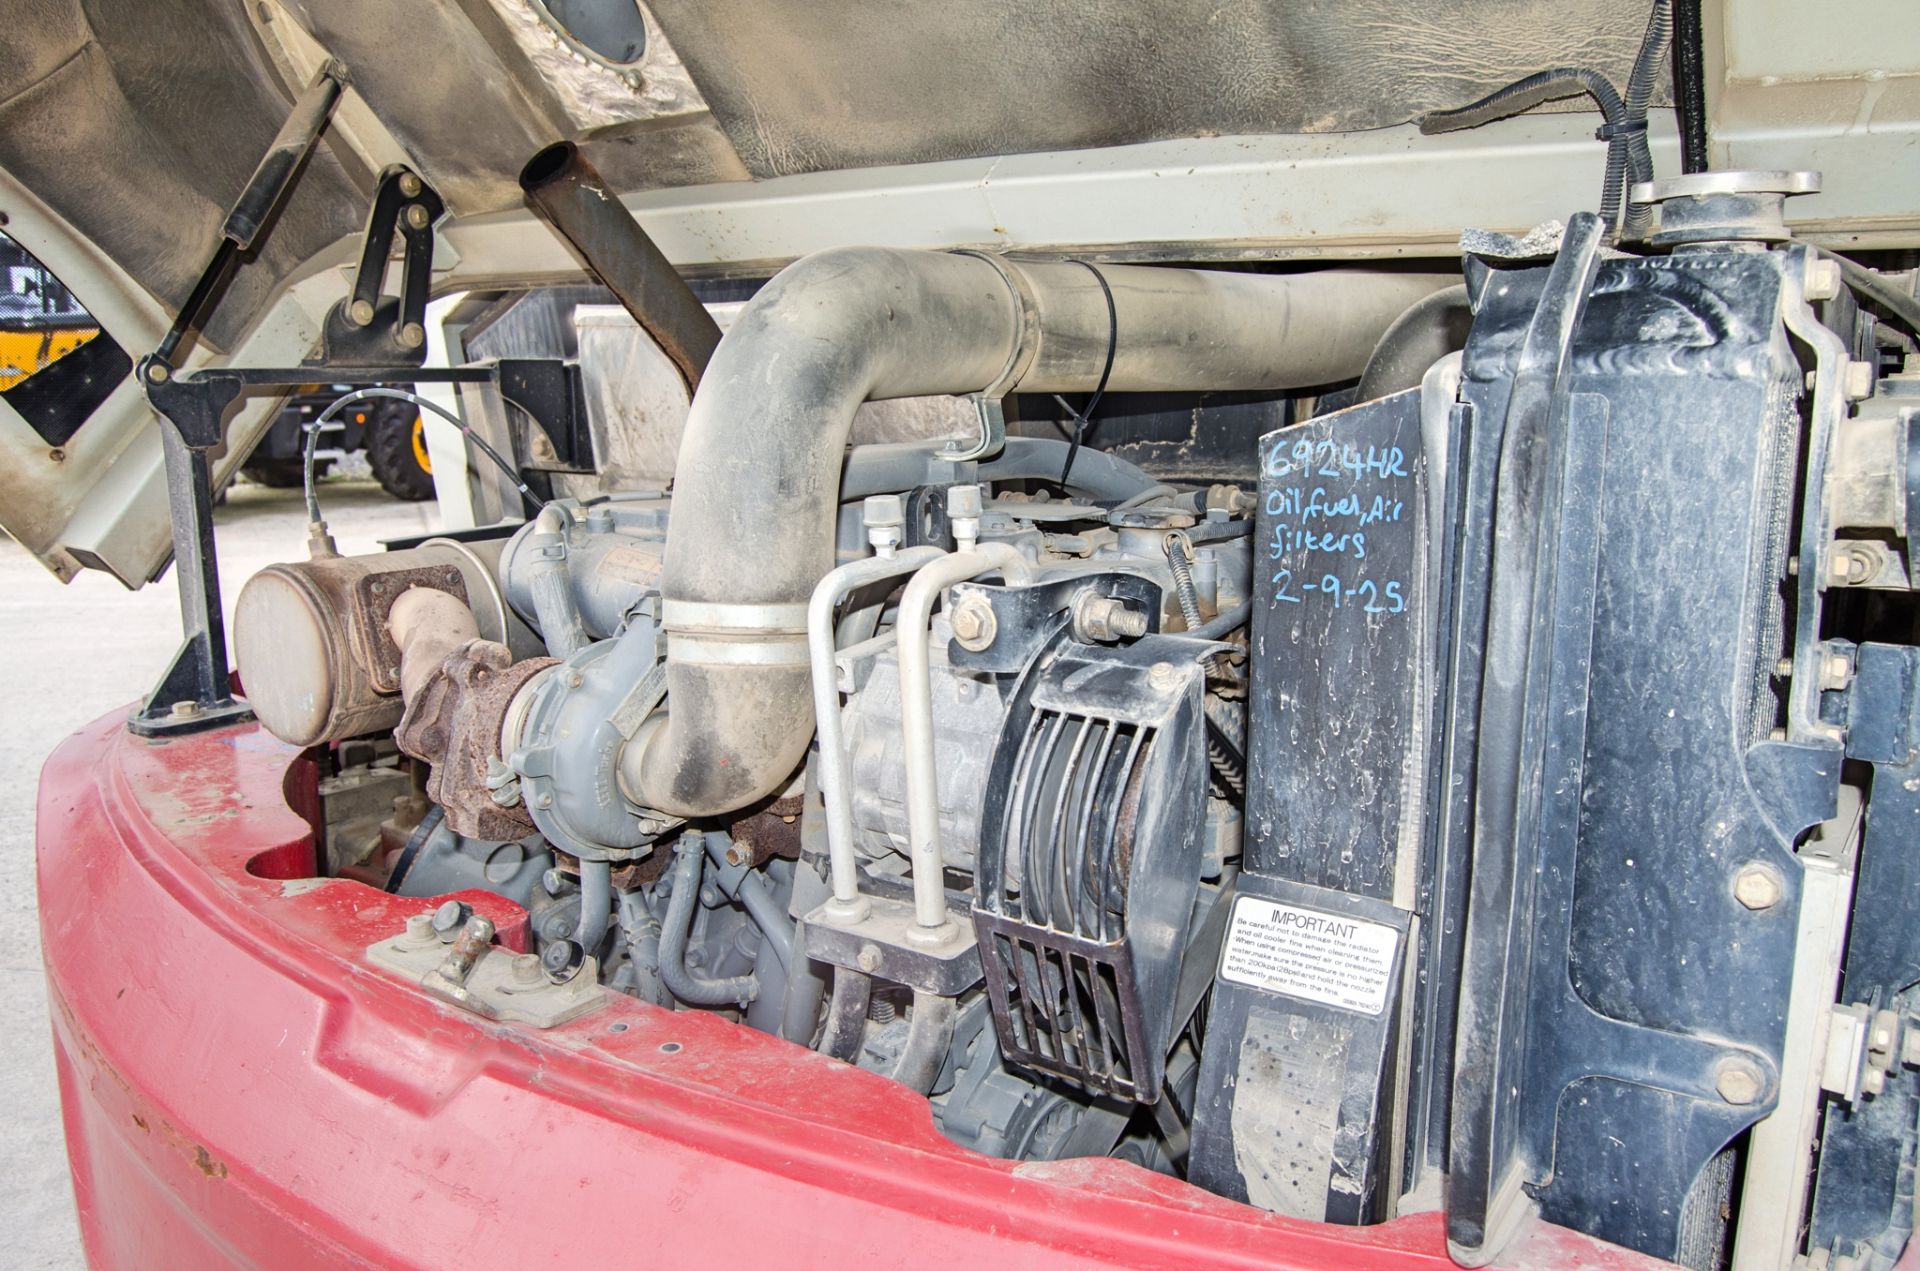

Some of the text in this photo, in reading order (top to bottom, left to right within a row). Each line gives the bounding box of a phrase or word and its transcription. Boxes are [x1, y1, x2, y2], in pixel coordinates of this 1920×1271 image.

[1267, 439, 1408, 480] 6924HR
[1272, 569, 1403, 613] 2-9-25
[1236, 917, 1248, 926] Be
[1248, 921, 1276, 932] careful
[1276, 927, 1290, 935] not
[1301, 932, 1332, 944] damage
[1333, 939, 1347, 948] the
[1348, 943, 1380, 954] radiator
[1271, 909, 1358, 939] IMPORTANT
[1237, 928, 1252, 937] and
[1252, 931, 1263, 939] oil
[1263, 934, 1287, 944] cooler
[1305, 944, 1326, 953] when
[1327, 948, 1360, 961] cleaning
[1362, 956, 1384, 966] them.
[1256, 942, 1276, 952] using
[1277, 947, 1322, 962] compressed
[1227, 964, 1267, 979] sufficiently
[1267, 975, 1288, 984] away
[1289, 978, 1307, 989] from
[1309, 984, 1322, 992] the
[1229, 955, 1246, 964] than
[1317, 975, 1334, 985] hold
[1336, 979, 1349, 988] the
[1350, 984, 1376, 994] nozzle
[1273, 956, 1290, 965] sure
[1291, 959, 1304, 968] the
[1305, 963, 1338, 976] pressure
[1359, 975, 1383, 986] higher
